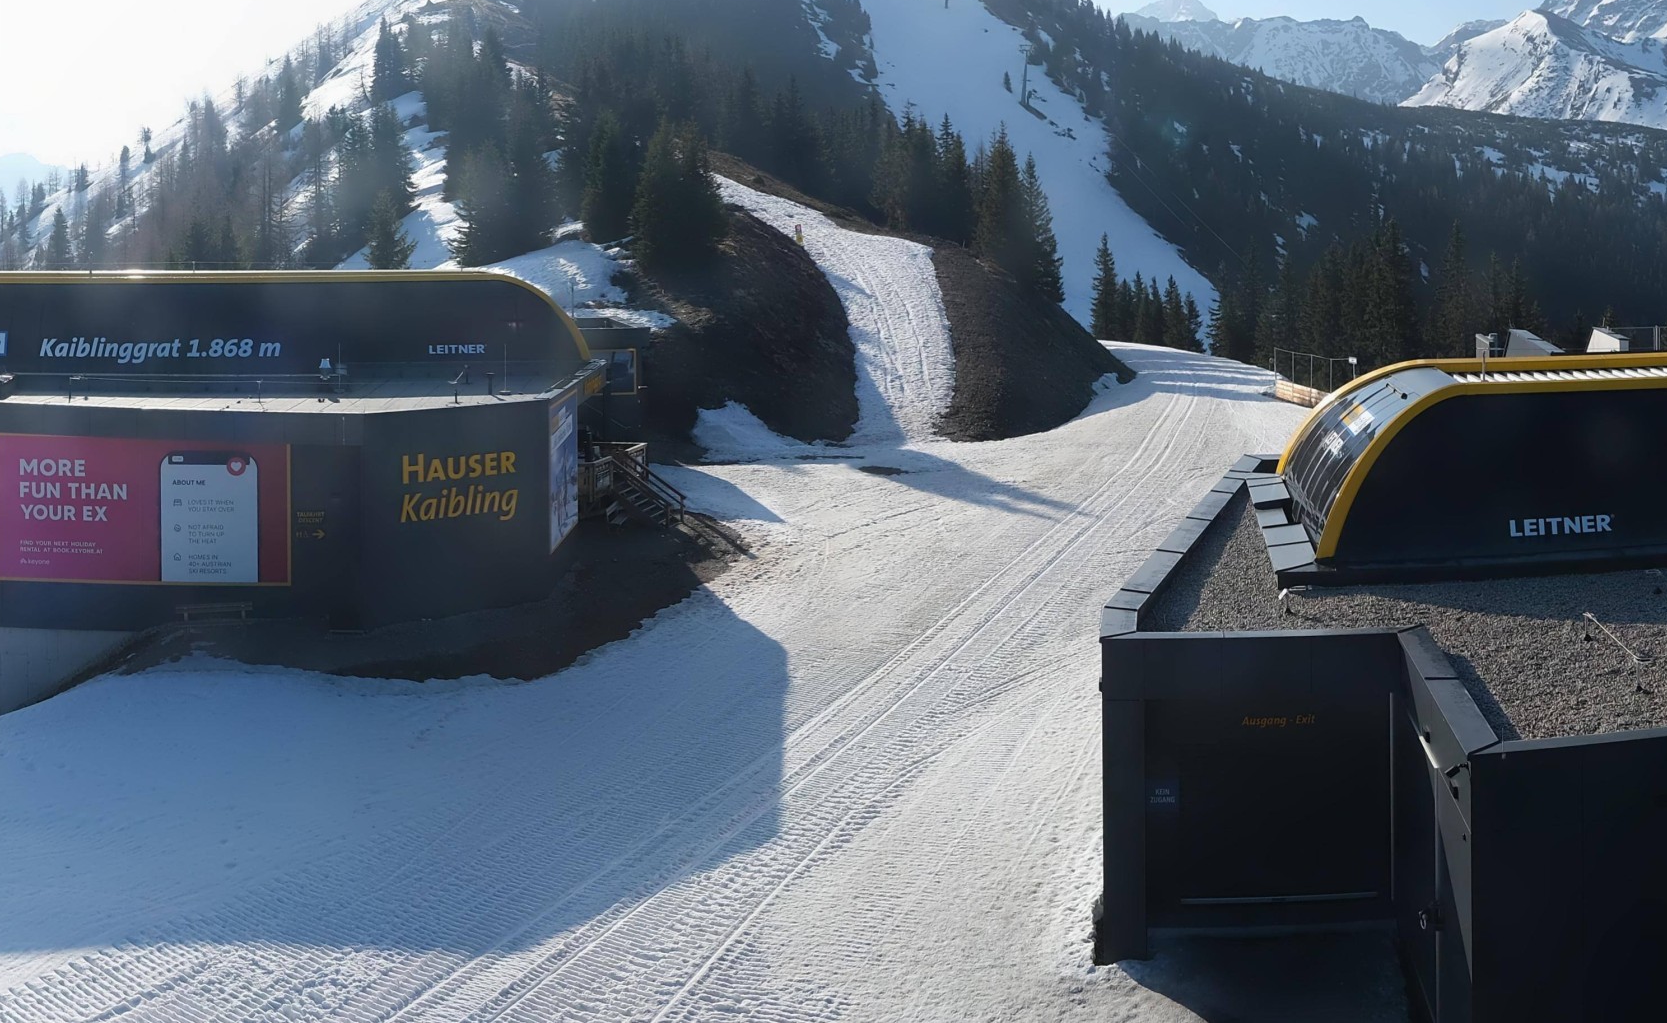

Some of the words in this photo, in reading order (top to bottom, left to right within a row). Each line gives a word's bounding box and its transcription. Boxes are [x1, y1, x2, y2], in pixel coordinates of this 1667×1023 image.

[39, 337, 180, 364] Kaiblinggrat
[187, 338, 253, 358] 1.868
[258, 343, 281, 358] m
[428, 344, 485, 355] LEITNER
[19, 458, 86, 477] MORE
[402, 451, 516, 485] HAUSER
[20, 481, 60, 498] FUN
[68, 482, 128, 500] THAN
[20, 504, 77, 521] YOUR
[83, 505, 108, 522] EX
[400, 484, 519, 523] Kaibling
[1509, 514, 1612, 537] LEITNER
[1241, 716, 1287, 727] Ausgang
[1295, 714, 1316, 724] Exit
